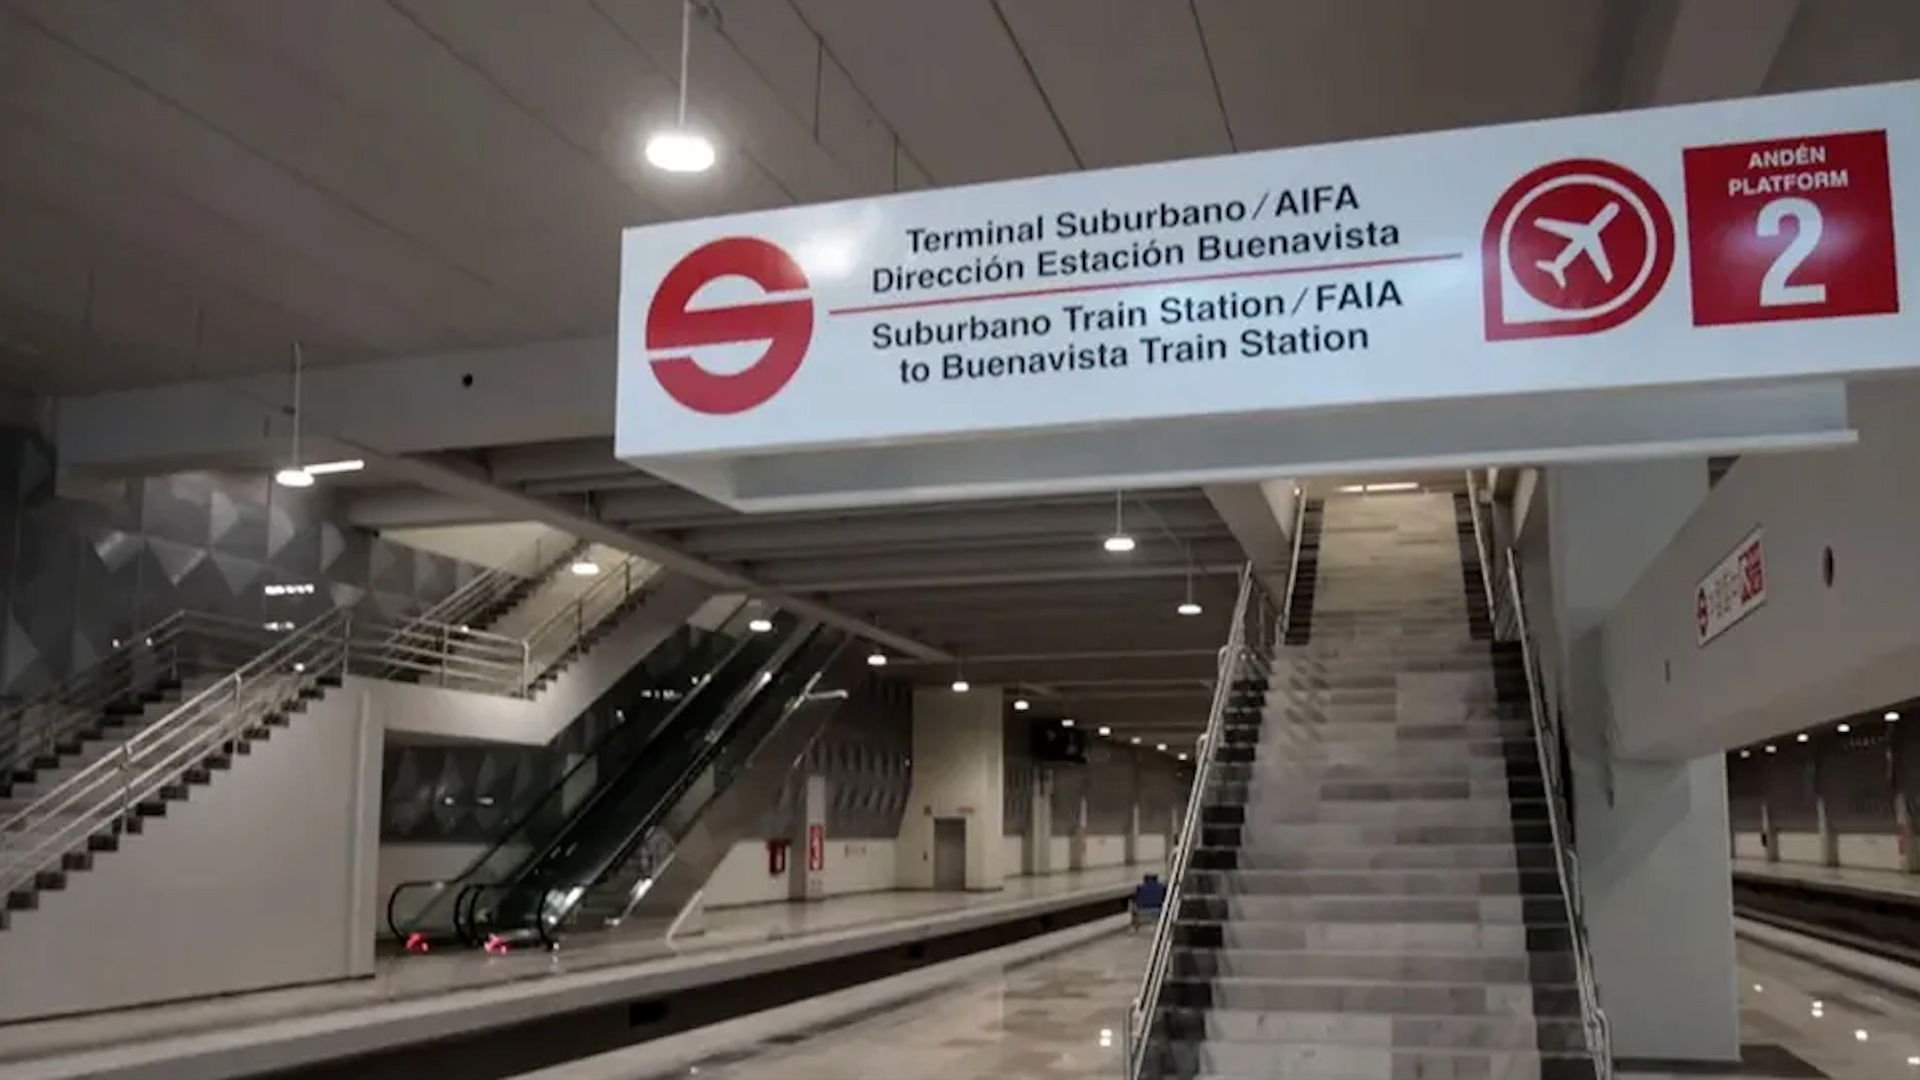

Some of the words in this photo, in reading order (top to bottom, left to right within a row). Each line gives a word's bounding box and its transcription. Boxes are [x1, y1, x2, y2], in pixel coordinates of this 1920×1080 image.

[1727, 169, 1849, 197] PLATFORM
[1748, 143, 1826, 169] ANDÉN
[906, 215, 1044, 254] Terminal
[1056, 200, 1247, 239] Suburbano
[1756, 197, 1827, 307] 2
[872, 254, 1024, 293] Dirección
[1038, 239, 1184, 277] Estación
[1198, 221, 1400, 262] Buenavista
[872, 314, 1051, 350] Suburbano
[1063, 301, 1147, 332] Train
[1160, 291, 1286, 325] Station
[900, 357, 931, 384] to
[942, 343, 1128, 380] Buenavista
[1140, 333, 1227, 365] Train
[1240, 324, 1369, 358] Station
